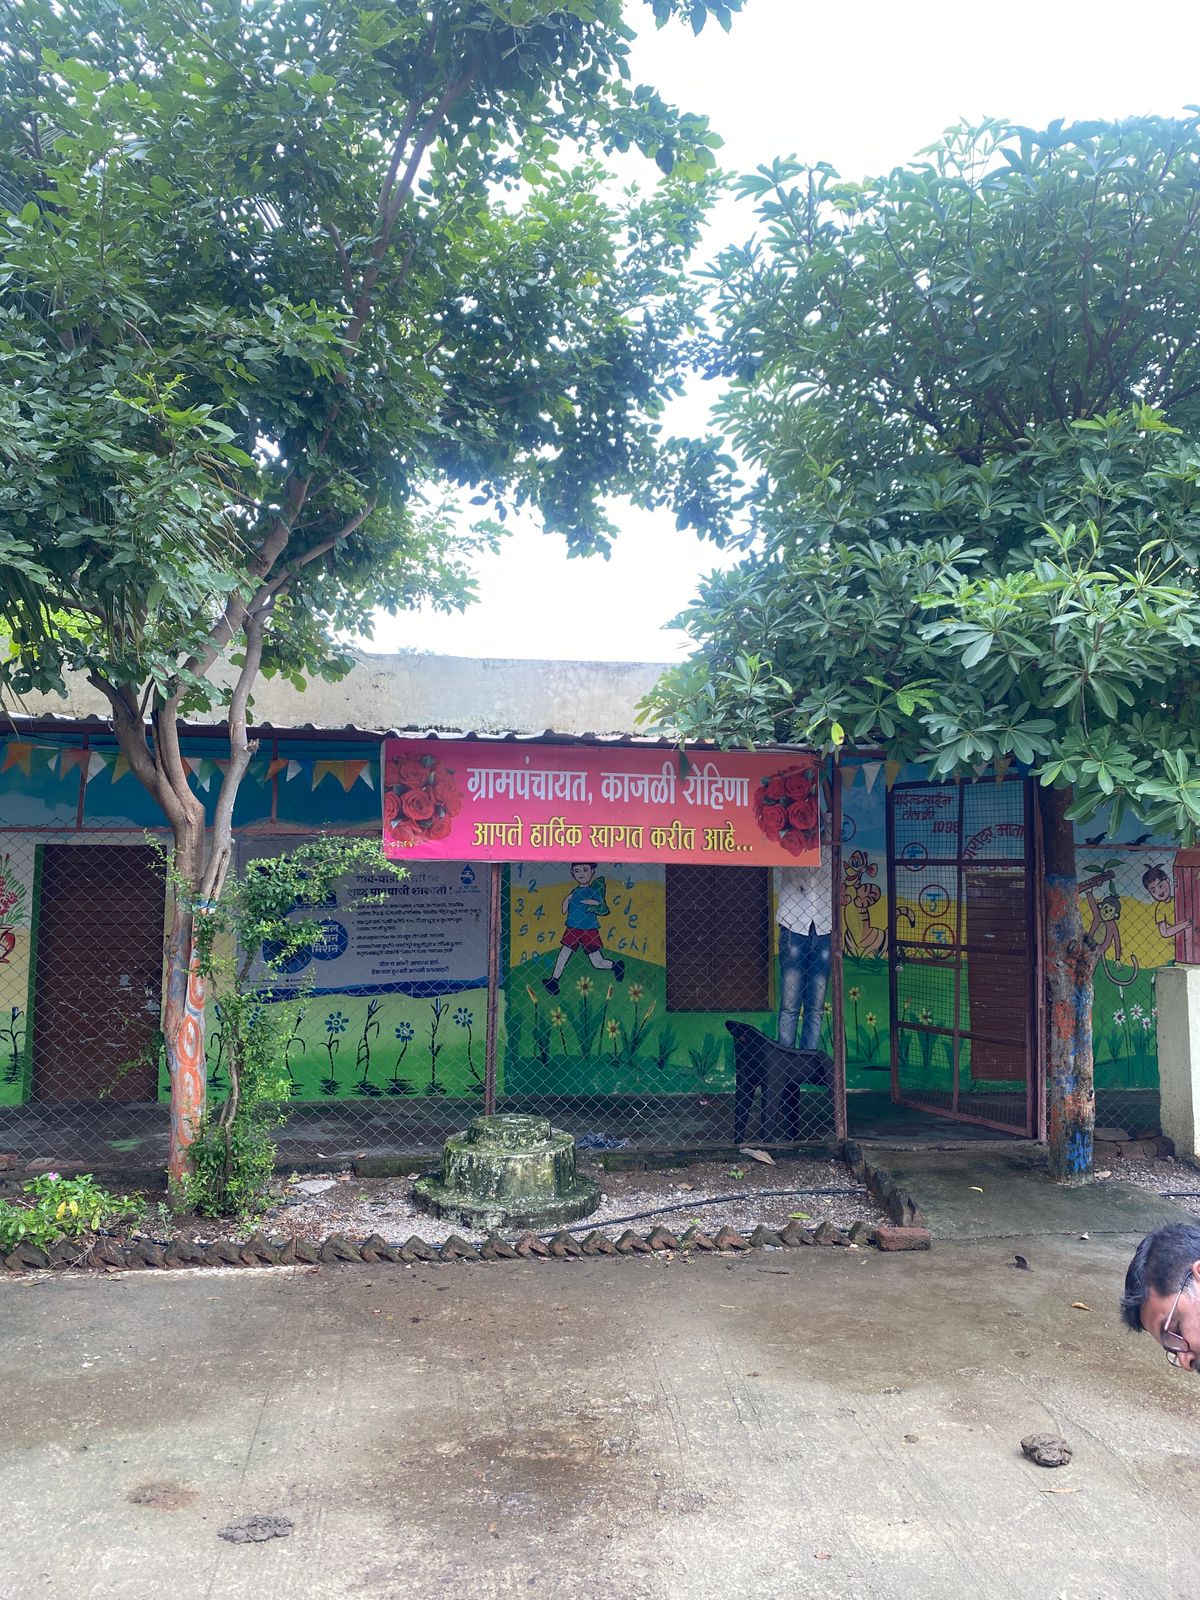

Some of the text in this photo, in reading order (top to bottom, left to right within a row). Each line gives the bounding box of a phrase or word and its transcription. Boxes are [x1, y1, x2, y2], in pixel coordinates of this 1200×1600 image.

[467, 756, 750, 810] ग्रामपंचायत, काजळी रोहिणा
[472, 815, 753, 852] आपले हार्दिक स्वागत करीत आहे...
[311, 943, 338, 953] मिशन
